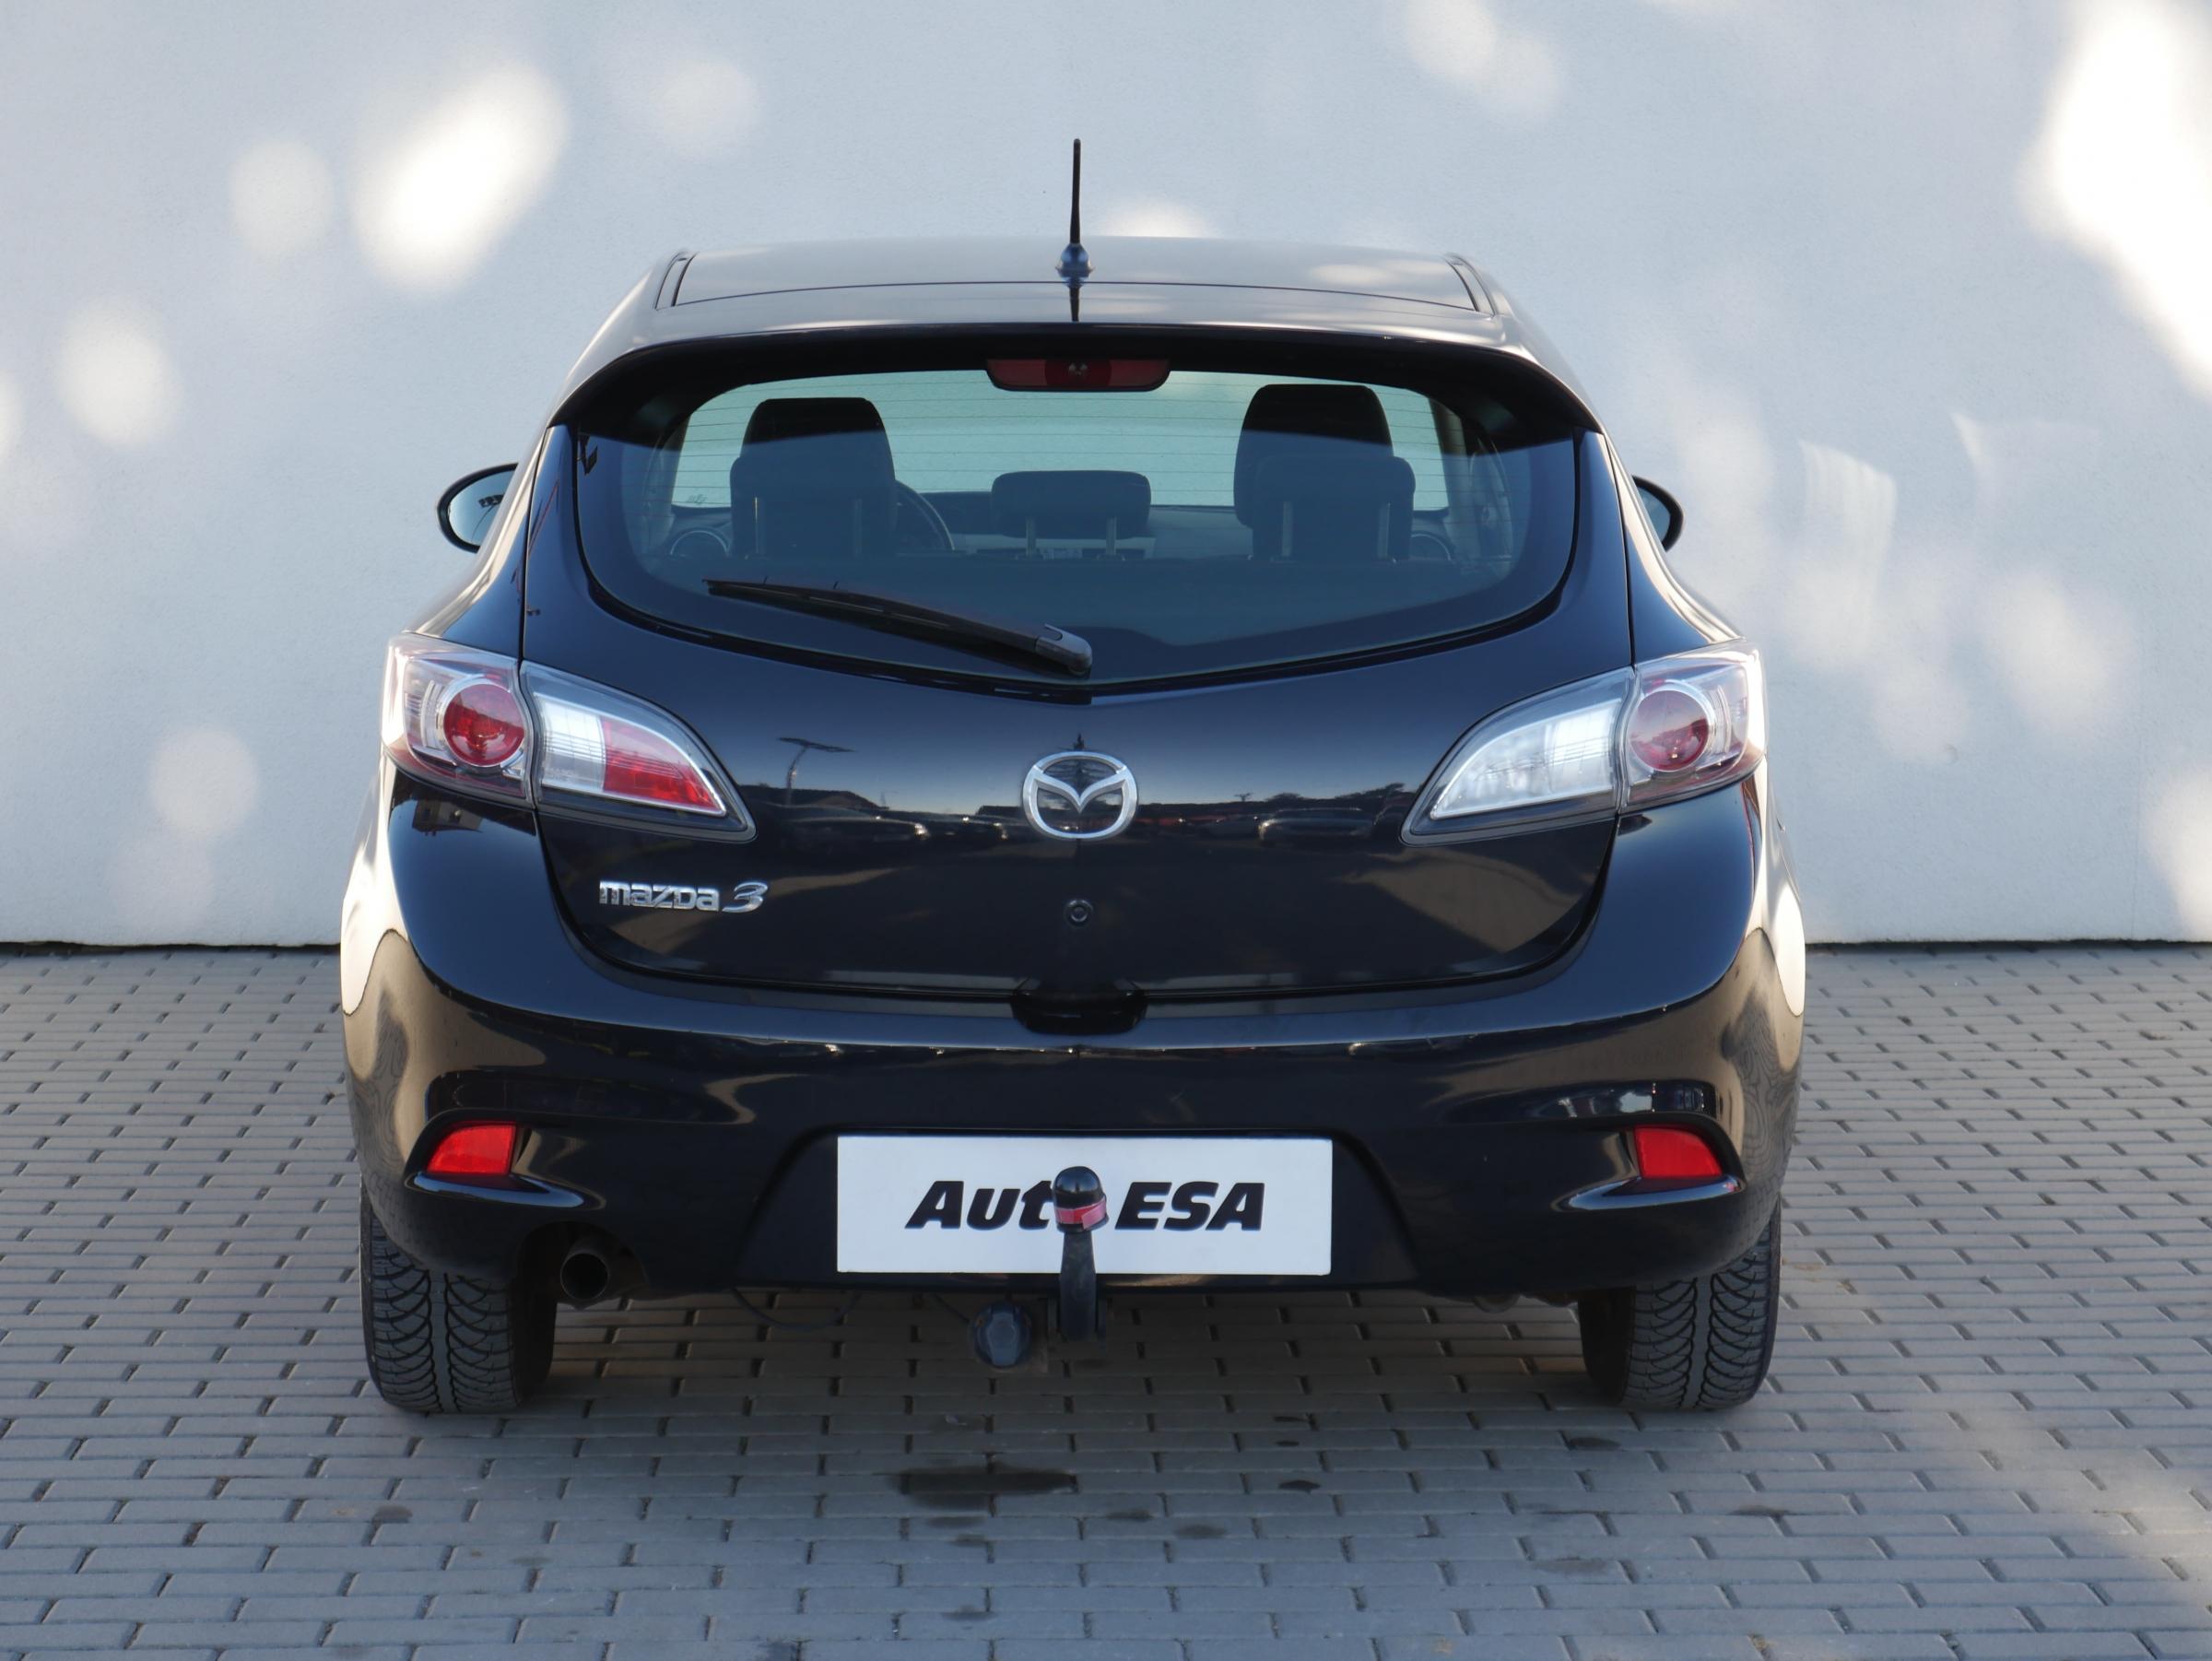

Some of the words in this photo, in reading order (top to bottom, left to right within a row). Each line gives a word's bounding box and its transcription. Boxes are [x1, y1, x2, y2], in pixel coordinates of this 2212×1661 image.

[722, 881, 768, 913] 3
[904, 1180, 1055, 1231] Aut
[1114, 1181, 1265, 1231] ESA
